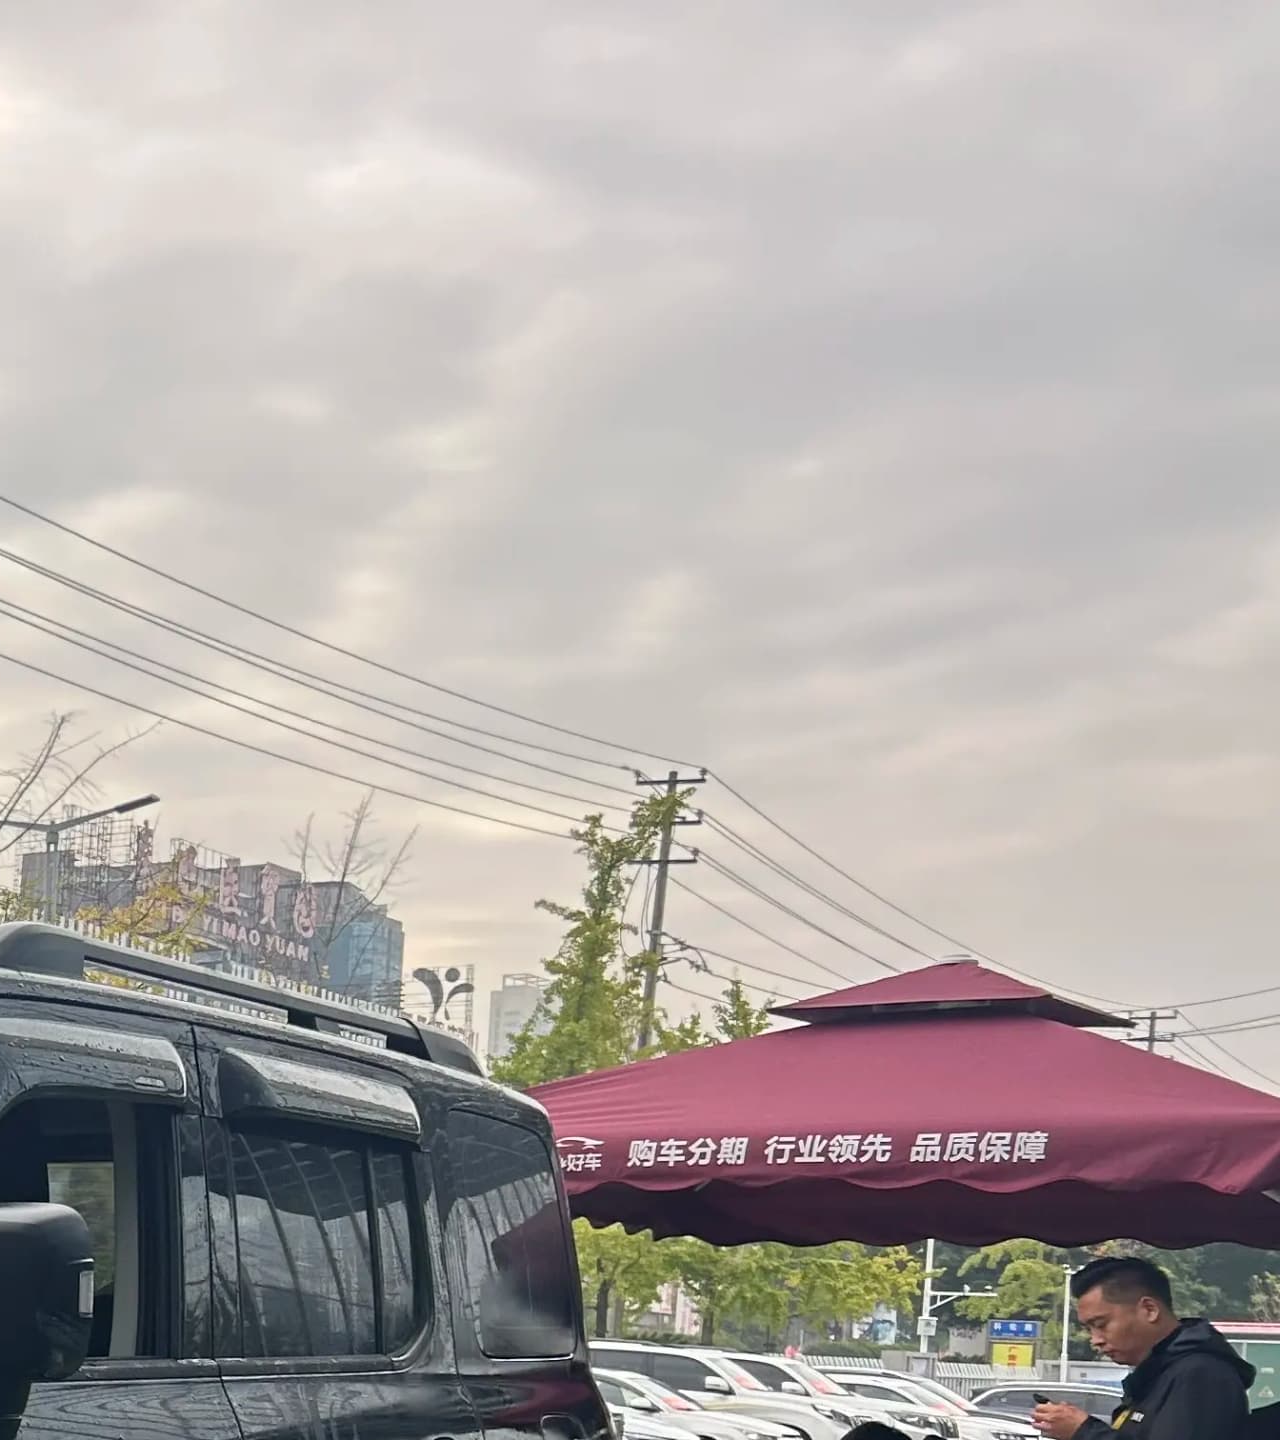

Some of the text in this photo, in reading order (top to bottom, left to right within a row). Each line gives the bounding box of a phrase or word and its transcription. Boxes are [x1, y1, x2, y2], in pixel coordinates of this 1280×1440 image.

[627, 1137, 749, 1168] 购车分期
[765, 1133, 892, 1164] 行业领先
[909, 1131, 1050, 1163] 品质保障
